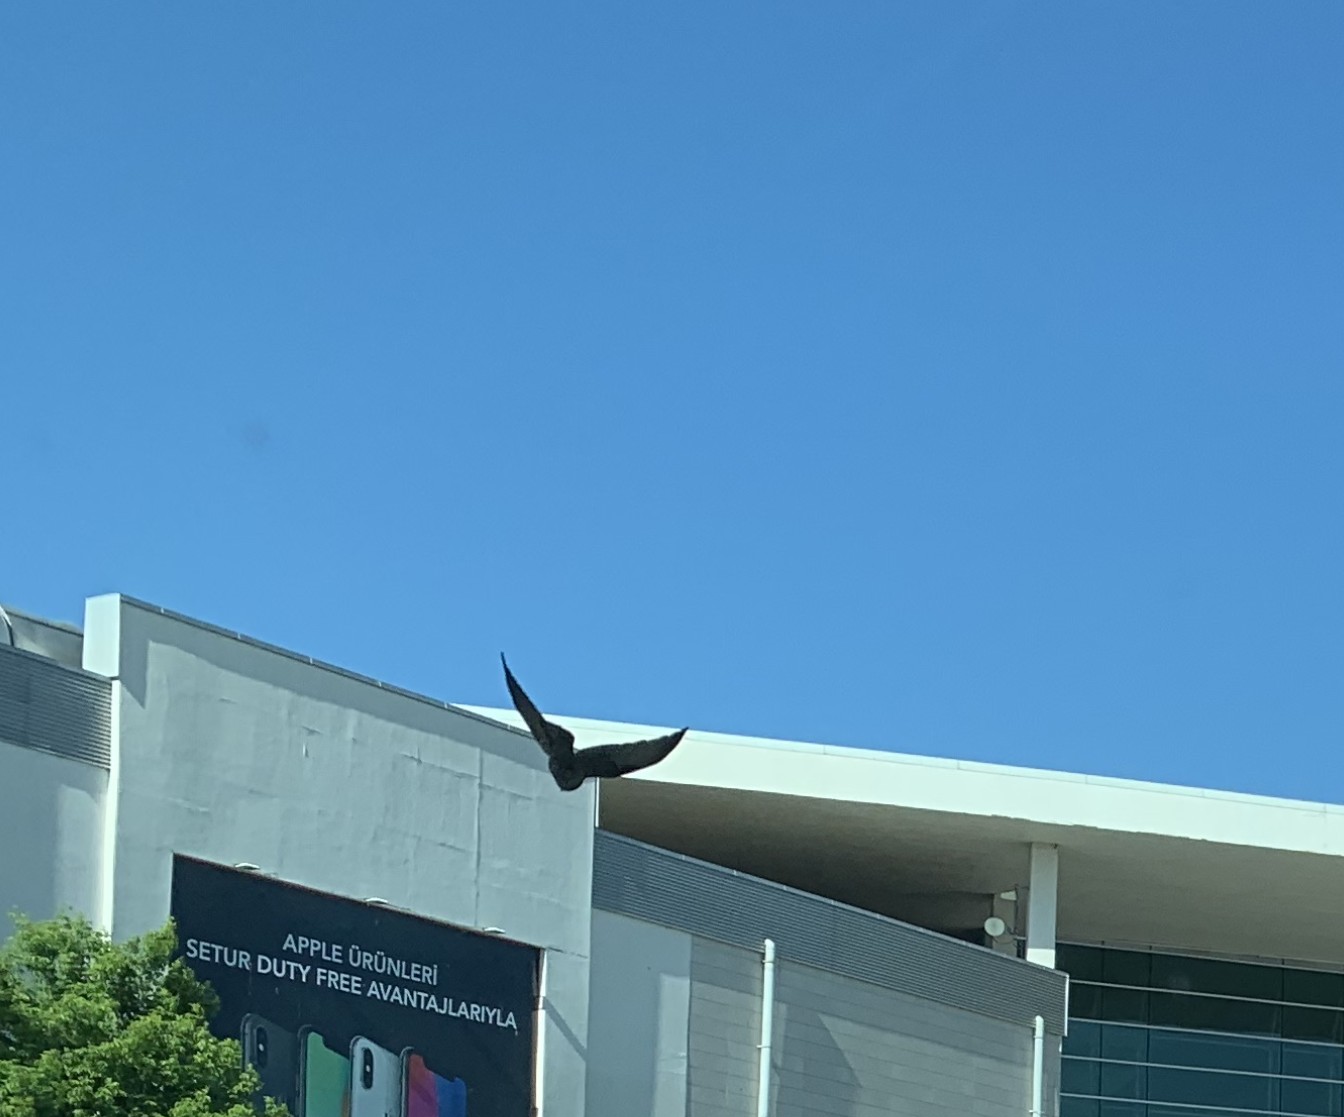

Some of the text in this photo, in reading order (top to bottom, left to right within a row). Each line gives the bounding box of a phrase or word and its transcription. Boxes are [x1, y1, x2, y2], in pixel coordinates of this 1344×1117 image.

[186, 938, 517, 1030] SETUR DUTY FREE AVANTAJLARIYLA
[282, 933, 438, 986] APPLE ÜRÜNLERİ
